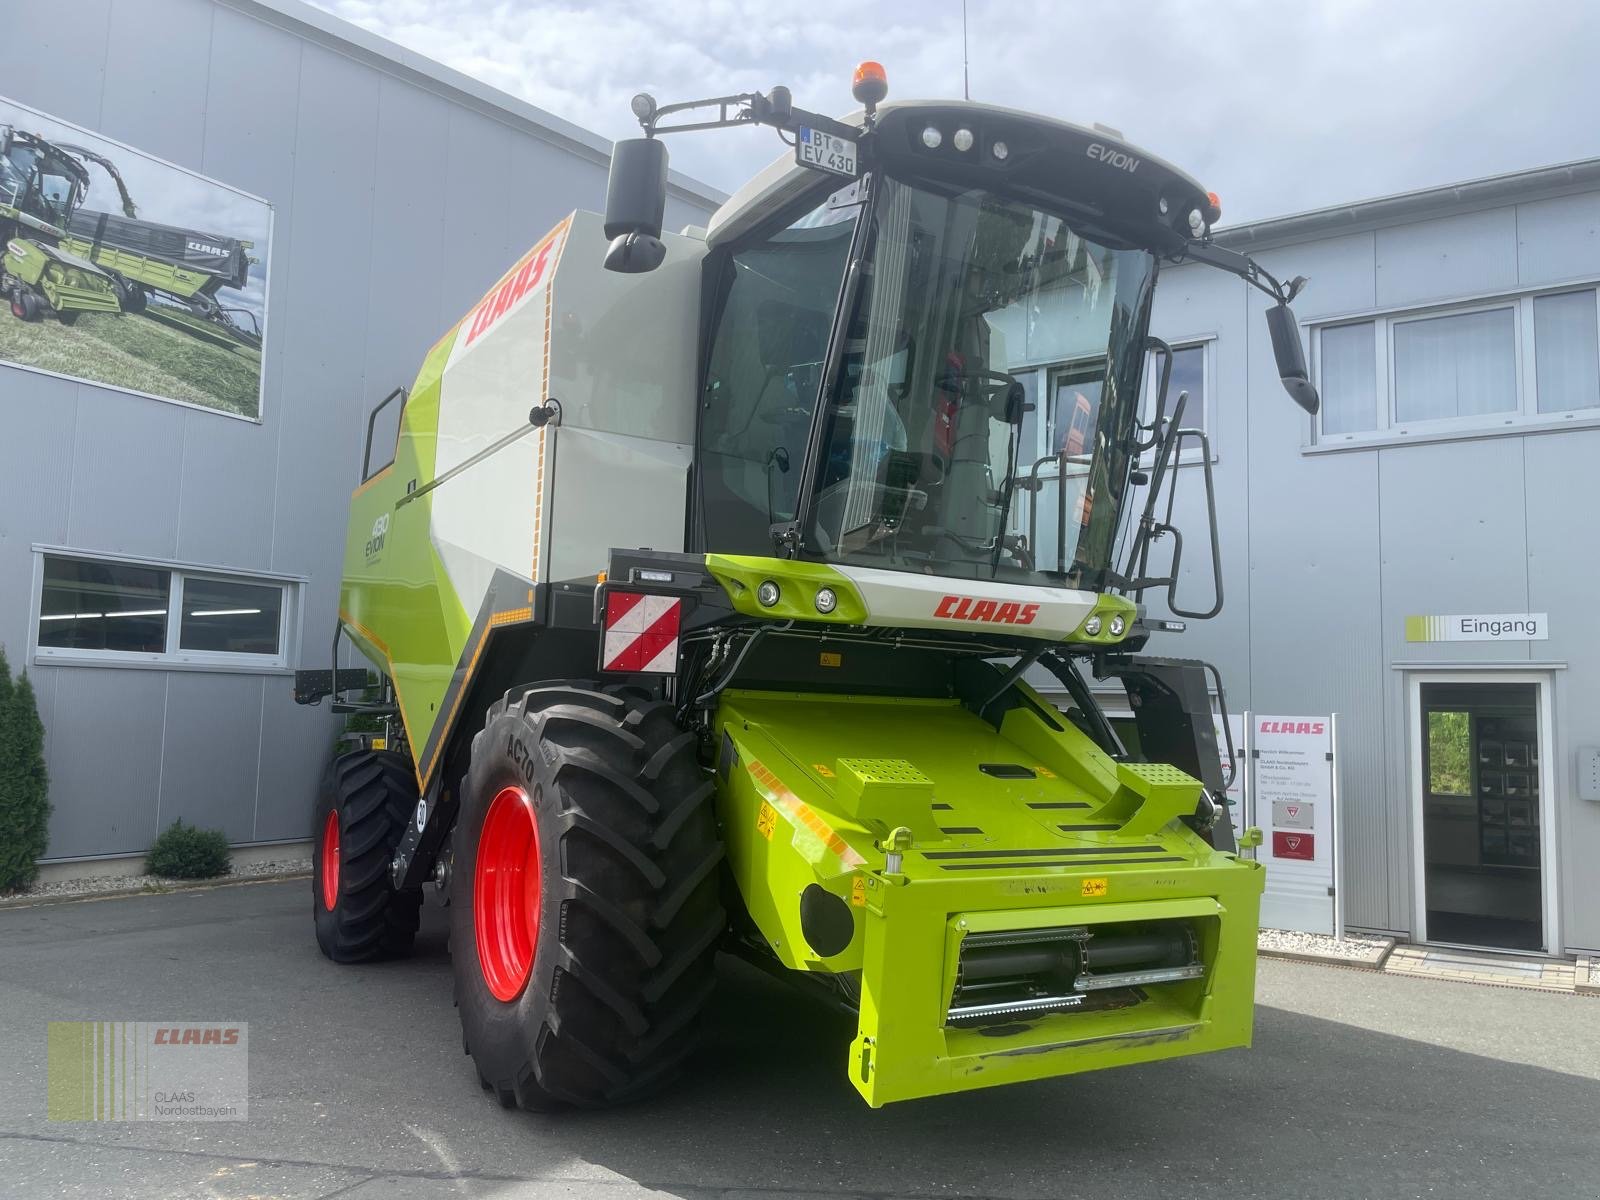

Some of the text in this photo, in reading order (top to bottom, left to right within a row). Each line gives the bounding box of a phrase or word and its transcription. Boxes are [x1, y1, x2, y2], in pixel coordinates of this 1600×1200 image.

[813, 132, 832, 150] BT
[804, 145, 854, 173] EV 430
[1086, 143, 1140, 173] EVION
[188, 242, 231, 258] CLAAS
[464, 239, 556, 348] CLAAS
[933, 595, 1041, 625] CLAAS
[1461, 618, 1537, 636] Eingang
[1260, 721, 1325, 735] CLAAS
[507, 733, 535, 784] AC70
